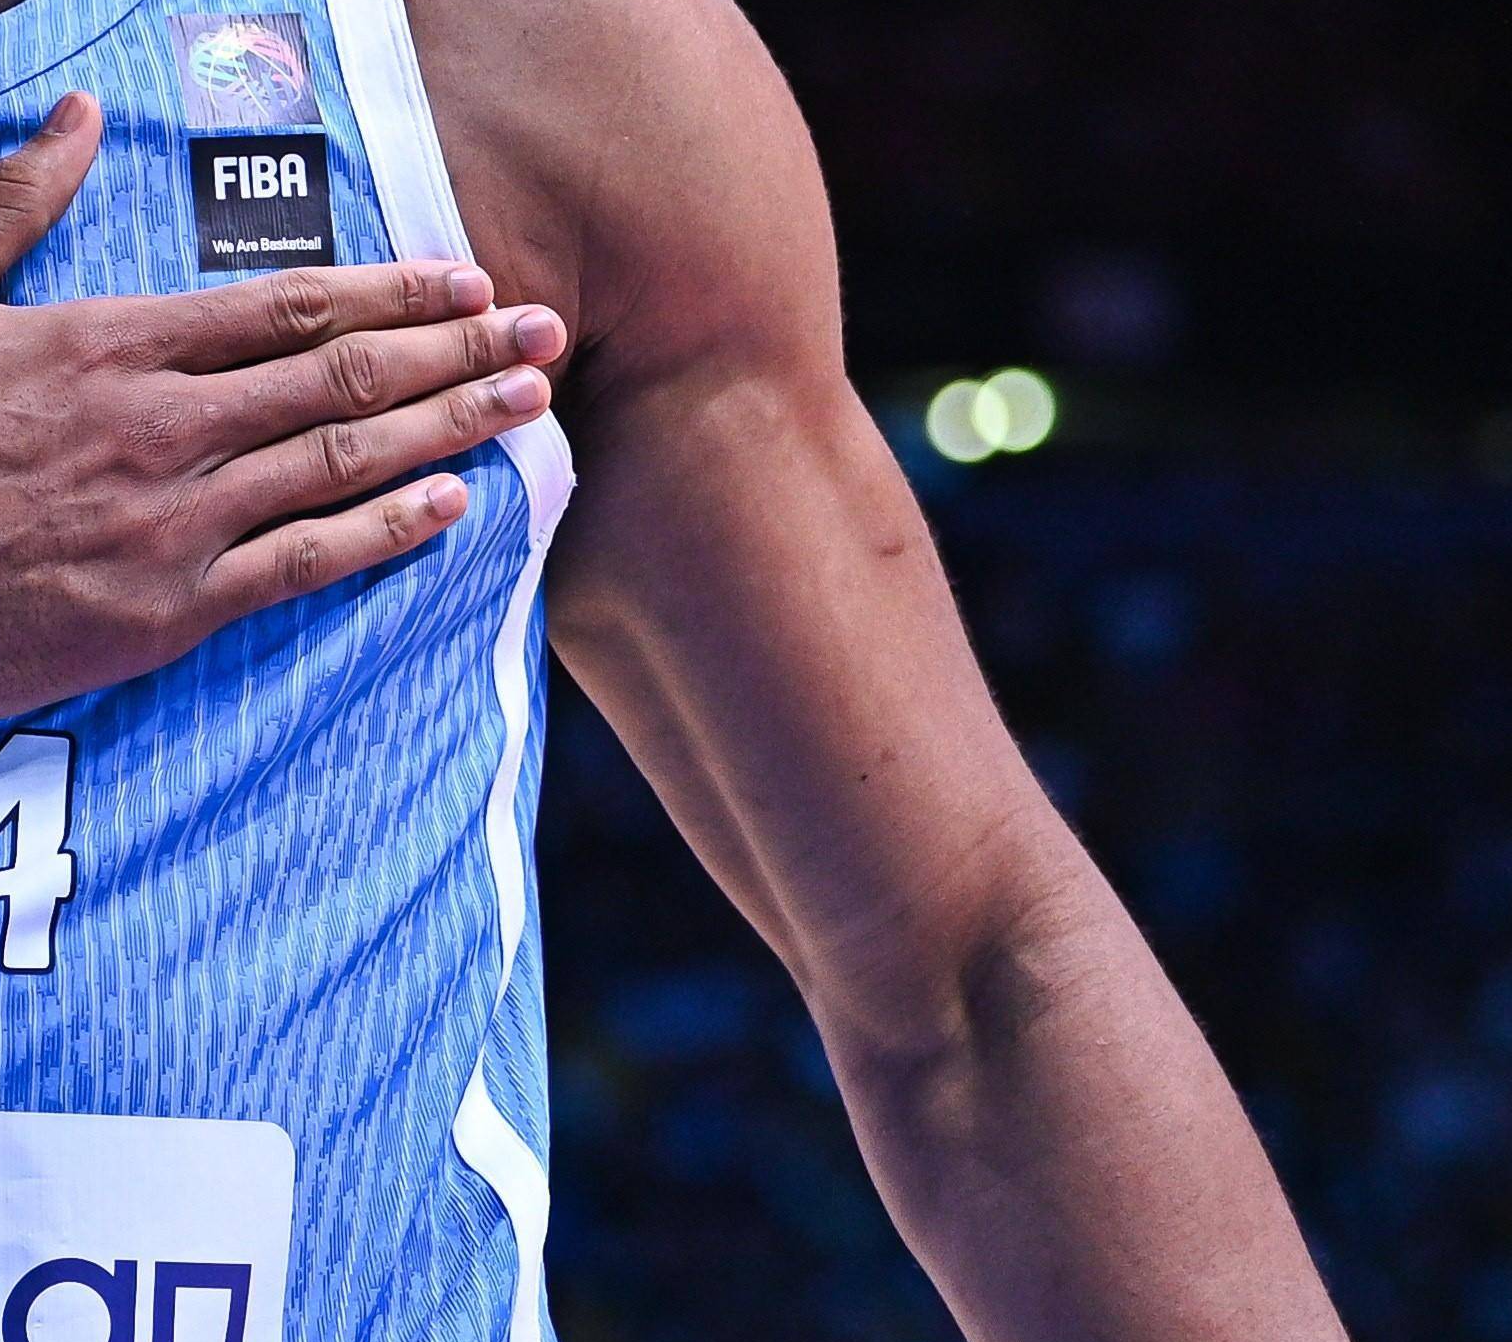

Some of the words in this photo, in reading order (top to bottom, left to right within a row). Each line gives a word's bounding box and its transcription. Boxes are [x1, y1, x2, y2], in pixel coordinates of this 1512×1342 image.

[212, 153, 309, 201] FIBA
[211, 239, 235, 254] We
[236, 237, 259, 252] Are
[260, 236, 322, 252] Basketball
